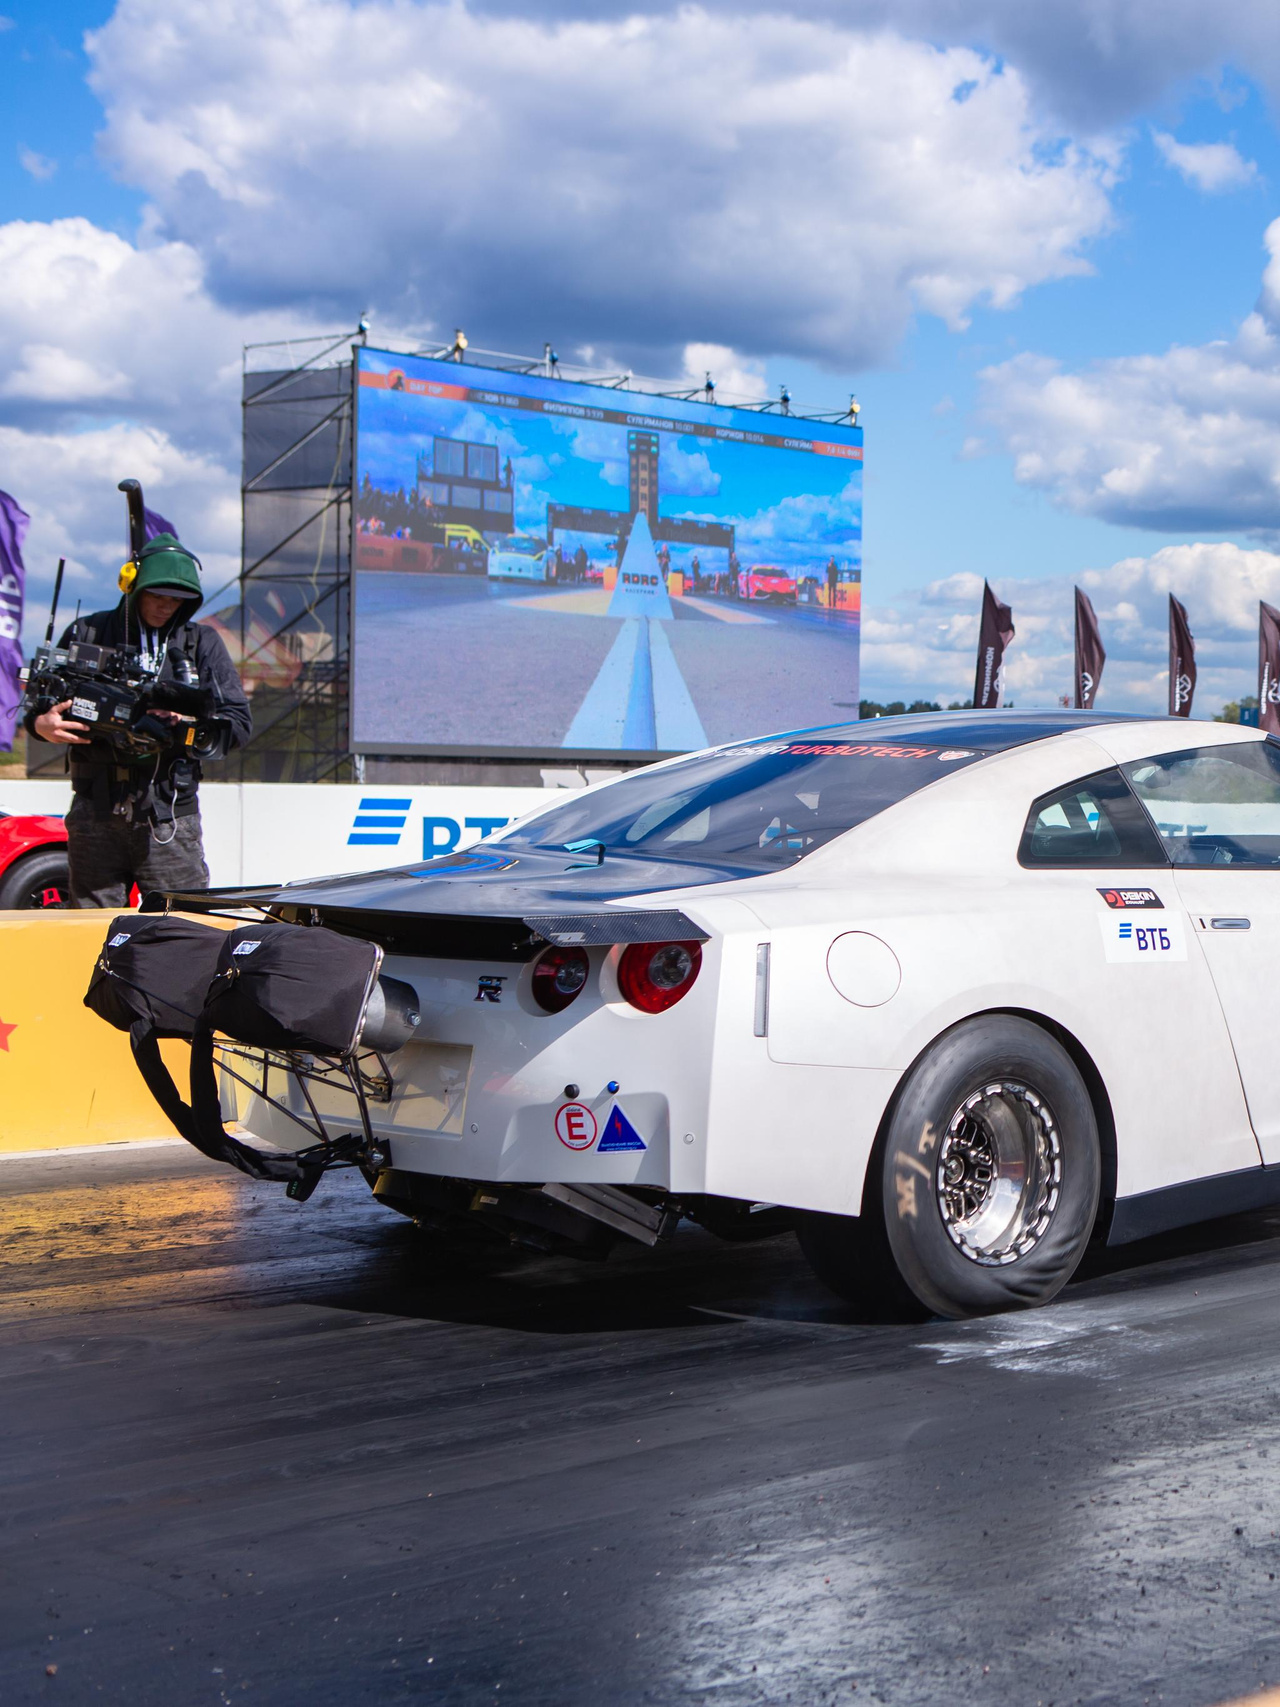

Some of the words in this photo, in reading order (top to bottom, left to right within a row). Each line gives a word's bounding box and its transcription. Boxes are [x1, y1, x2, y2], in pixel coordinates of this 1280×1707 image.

[409, 382, 425, 393] DAY
[428, 384, 443, 395] TOP
[626, 415, 673, 430] СУЛЕЙМАНОВ
[622, 571, 659, 587] RDRC
[981, 646, 995, 706] НОРНИКЕЛЬ
[423, 817, 518, 861] ВТ
[1135, 928, 1171, 951] ВТБ
[566, 1111, 587, 1140] E
